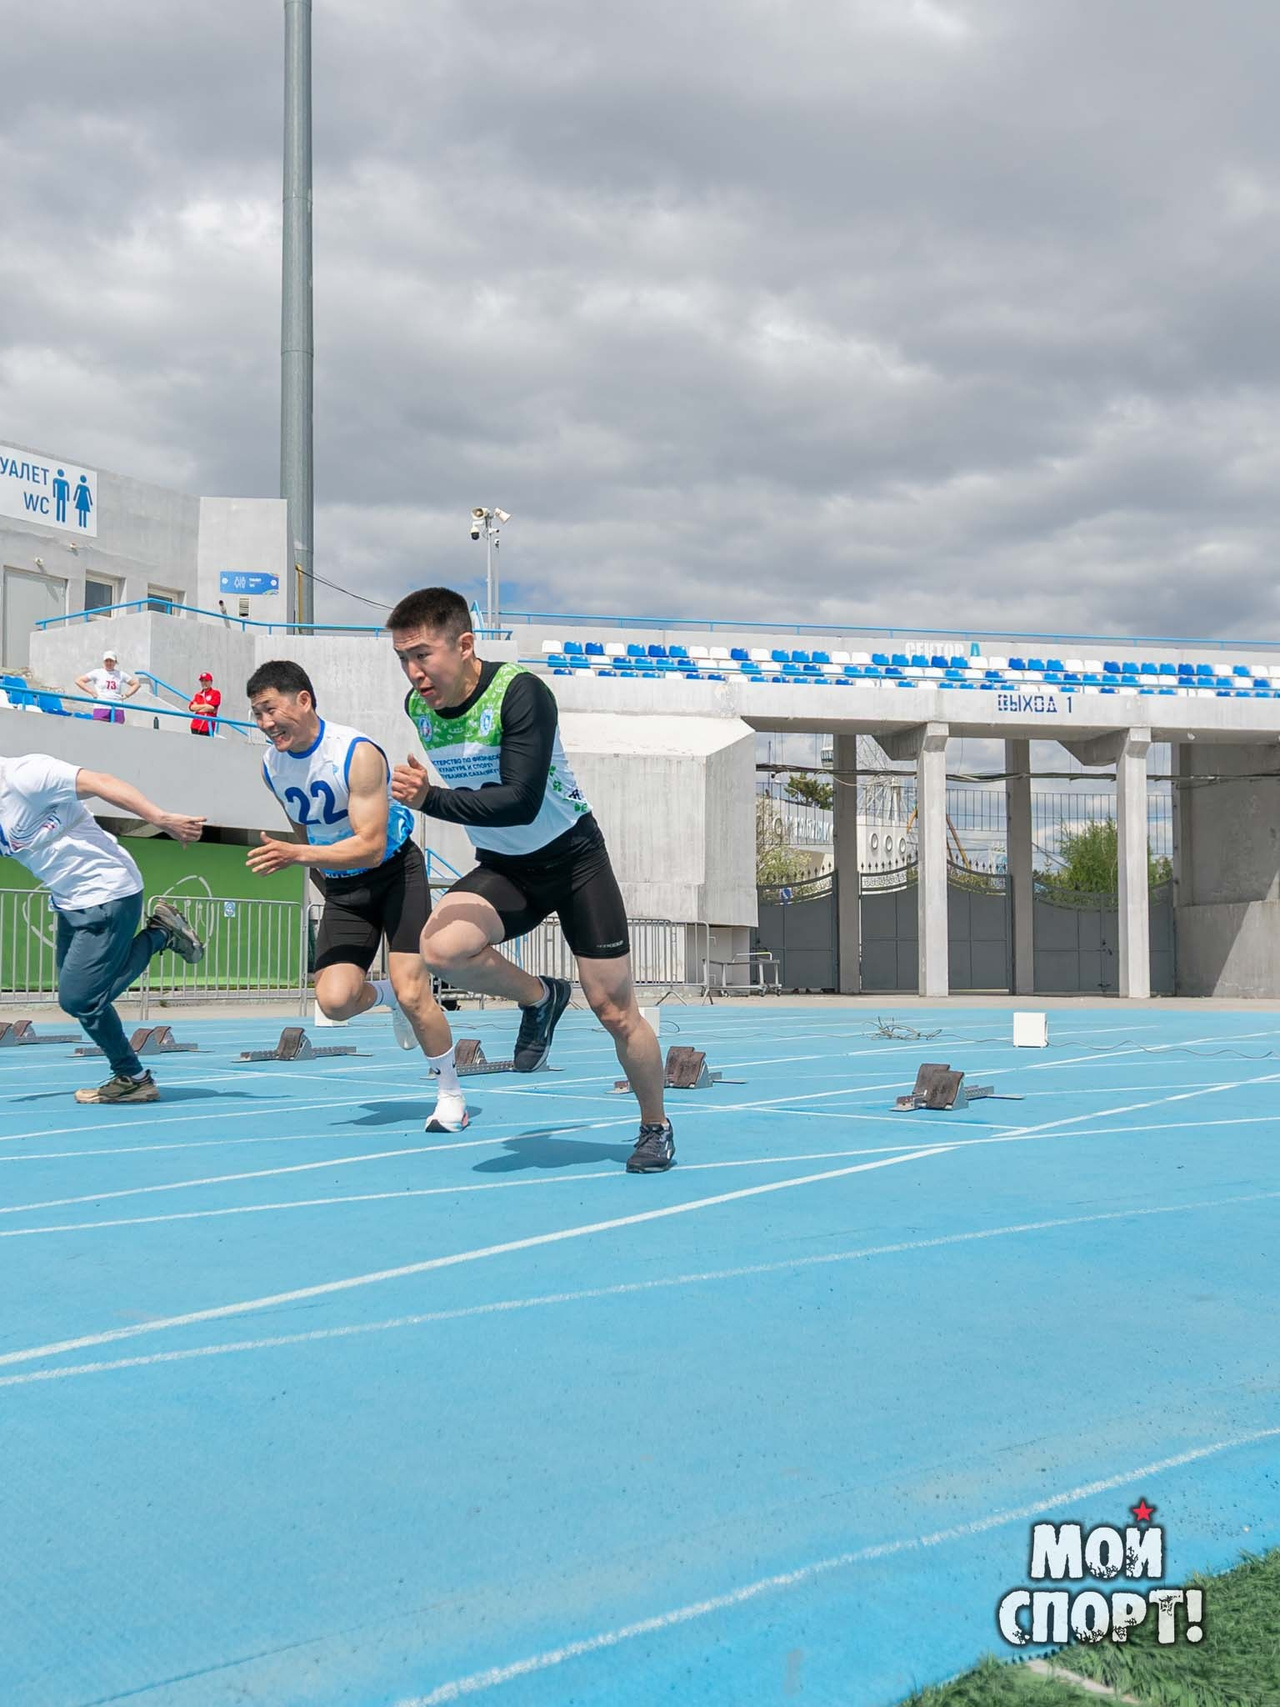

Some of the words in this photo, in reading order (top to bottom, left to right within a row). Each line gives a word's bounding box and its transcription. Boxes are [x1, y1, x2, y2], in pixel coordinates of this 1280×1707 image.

[23, 491, 50, 515] WC
[106, 680, 117, 690] 73
[998, 694, 1058, 713] ВЫХОД
[1066, 696, 1072, 713] 1
[285, 780, 349, 825] 22
